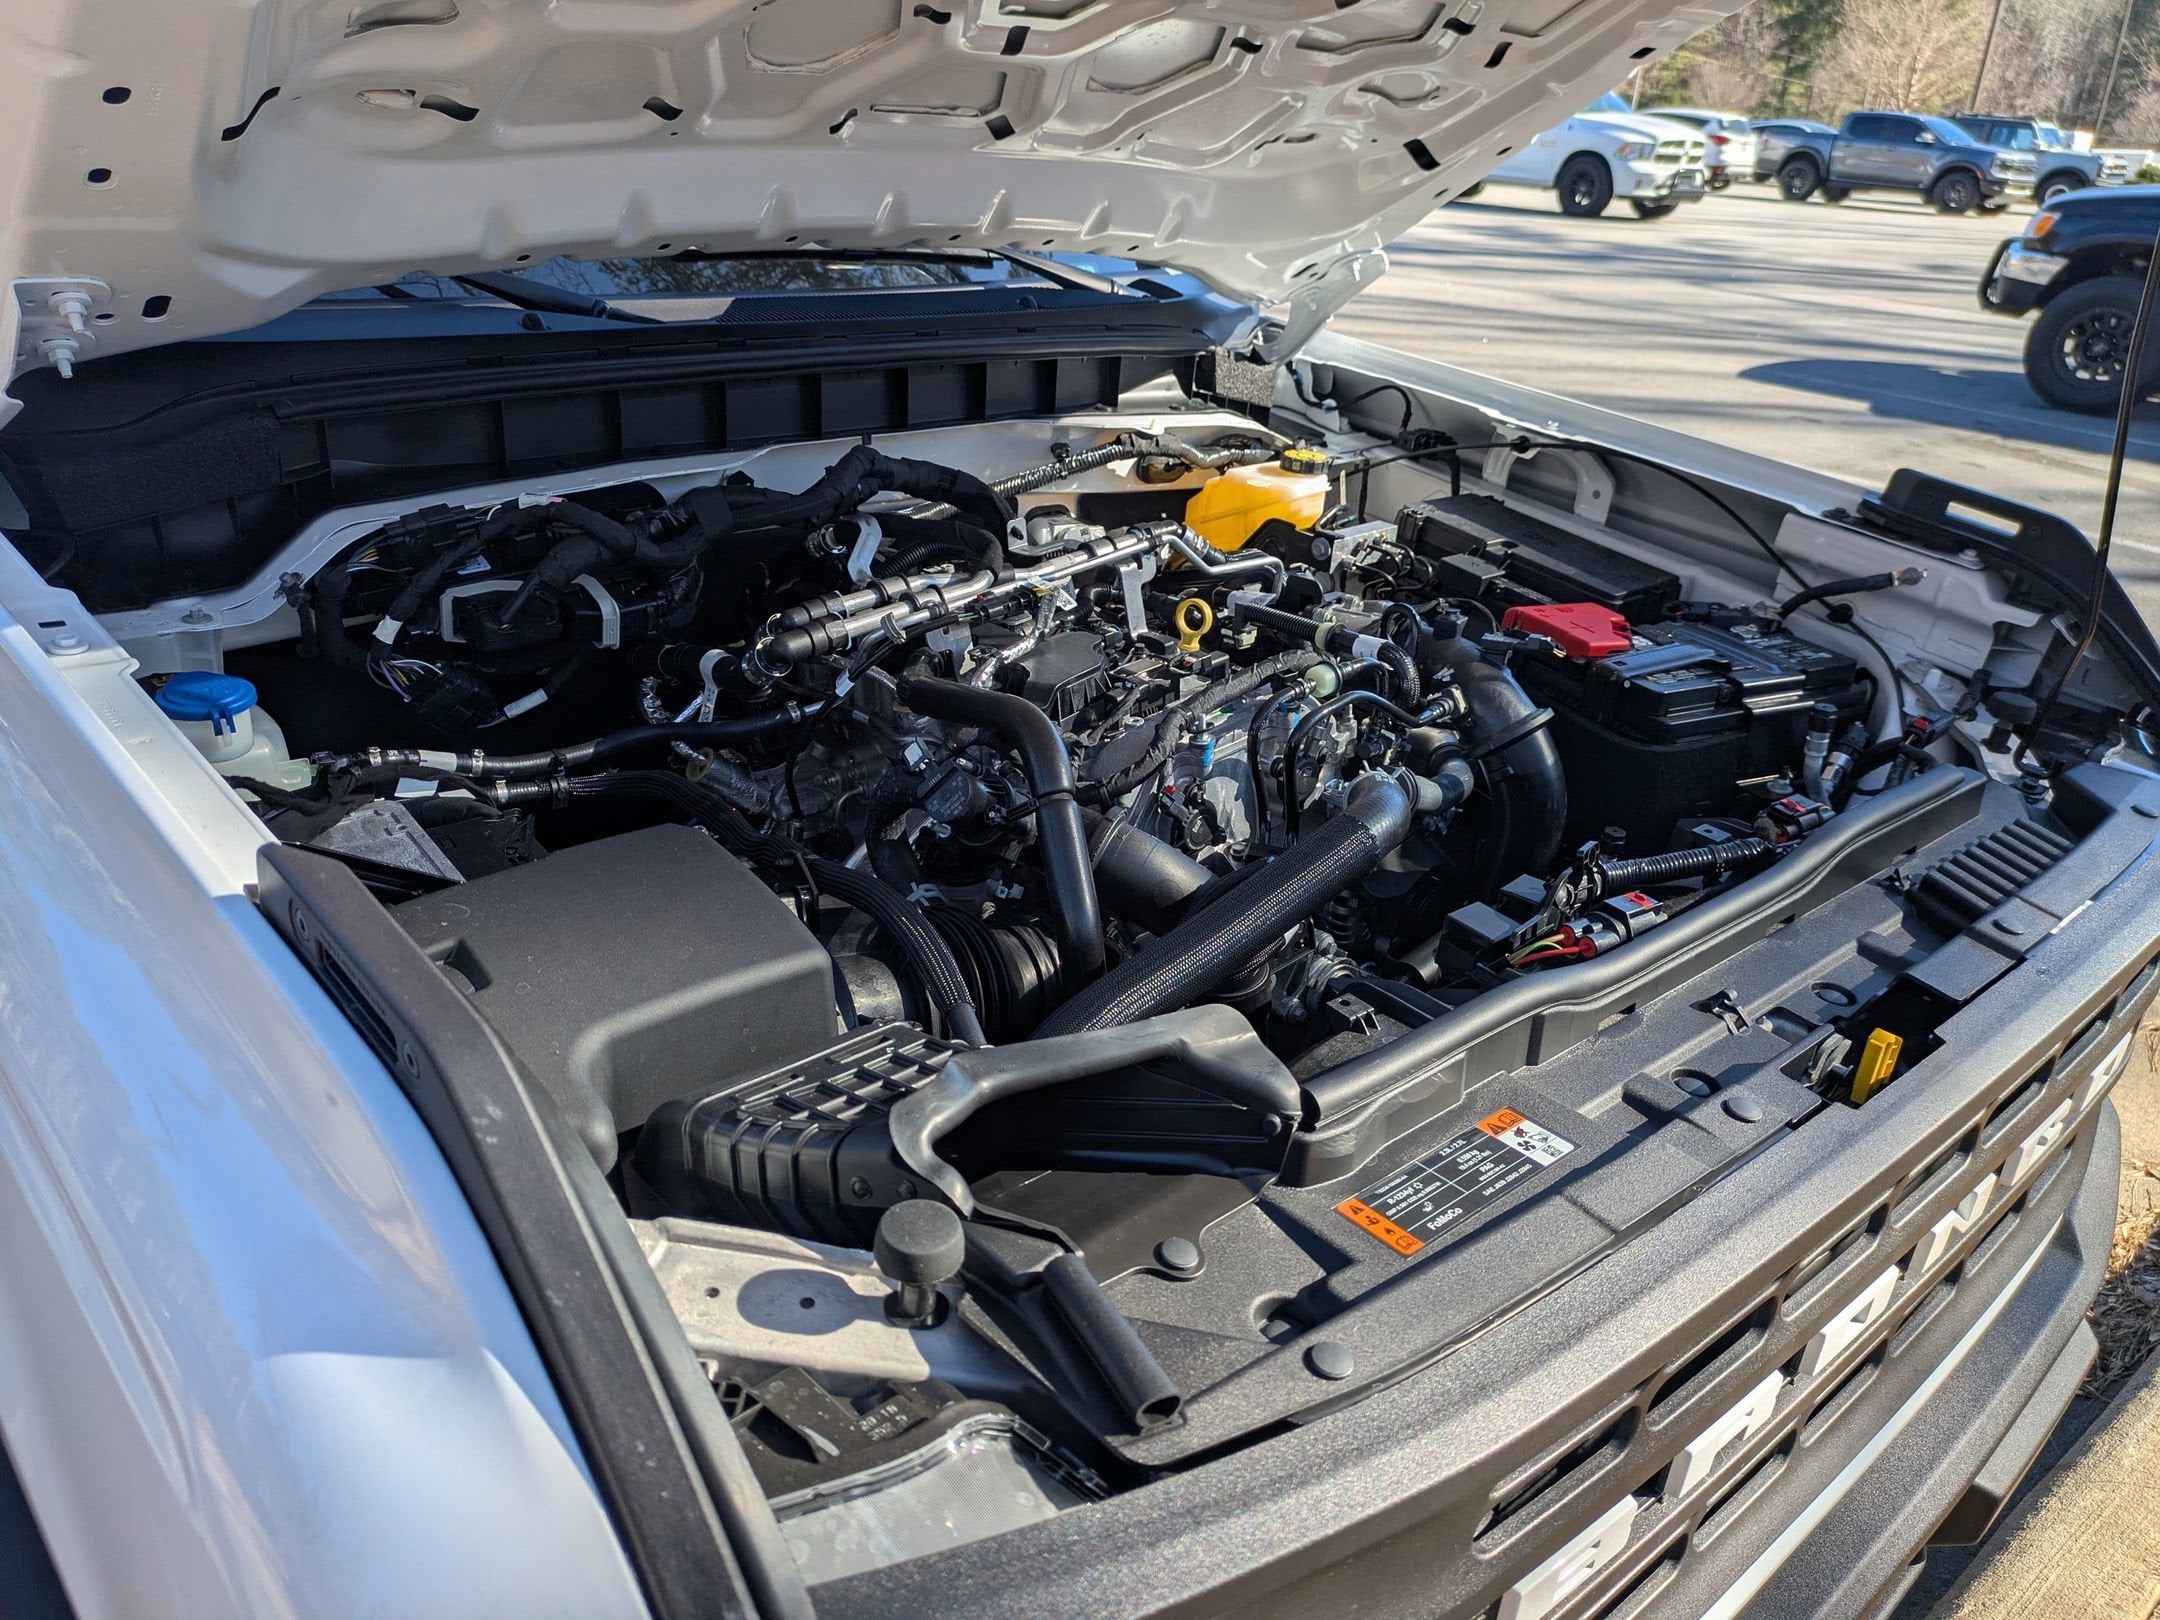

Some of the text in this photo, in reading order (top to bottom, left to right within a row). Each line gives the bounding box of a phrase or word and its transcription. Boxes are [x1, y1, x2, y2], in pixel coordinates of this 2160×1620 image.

[1479, 1162, 1495, 1173] PAG
[1482, 1186, 1496, 1197] SAE
[1426, 1207, 1463, 1231] FoMoCo
